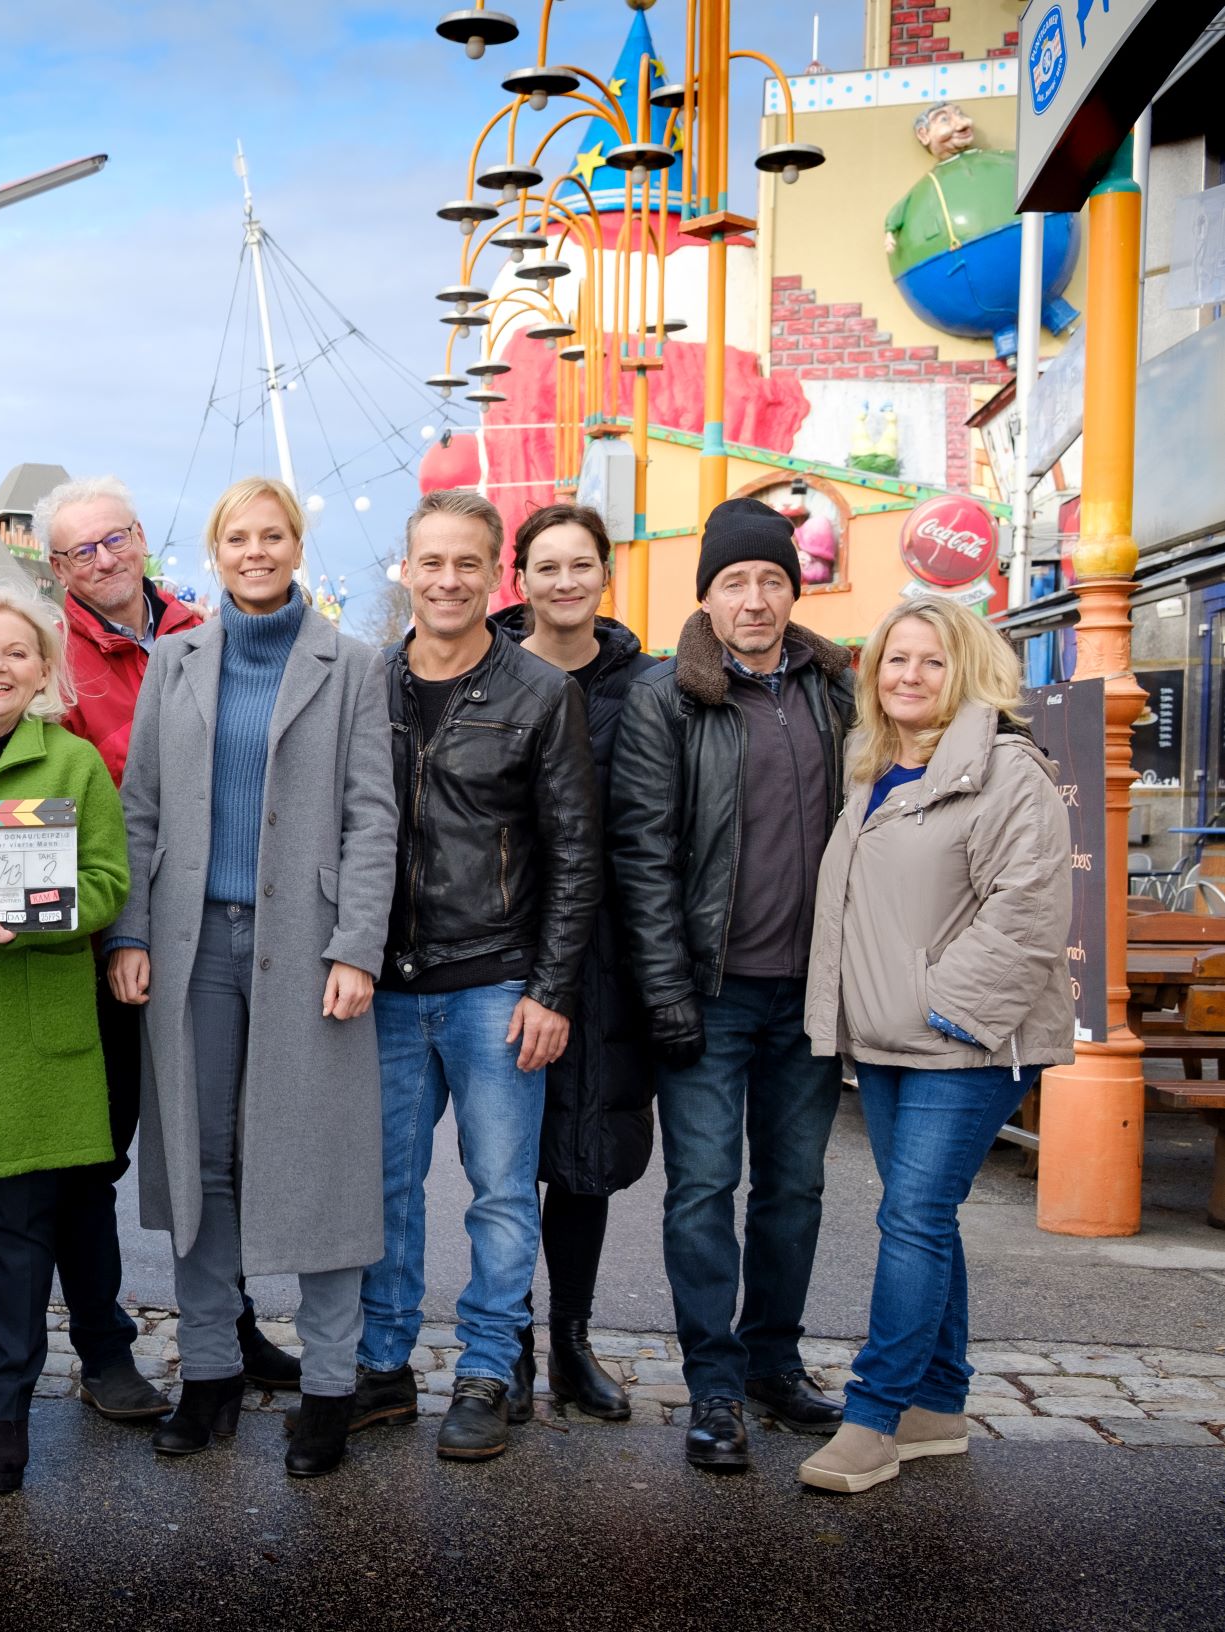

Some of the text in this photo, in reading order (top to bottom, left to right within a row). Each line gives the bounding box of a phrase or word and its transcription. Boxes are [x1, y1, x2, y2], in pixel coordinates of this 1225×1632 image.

[917, 518, 988, 559] Coca-Cola
[42, 860, 57, 885] 2
[7, 913, 26, 921] DAY
